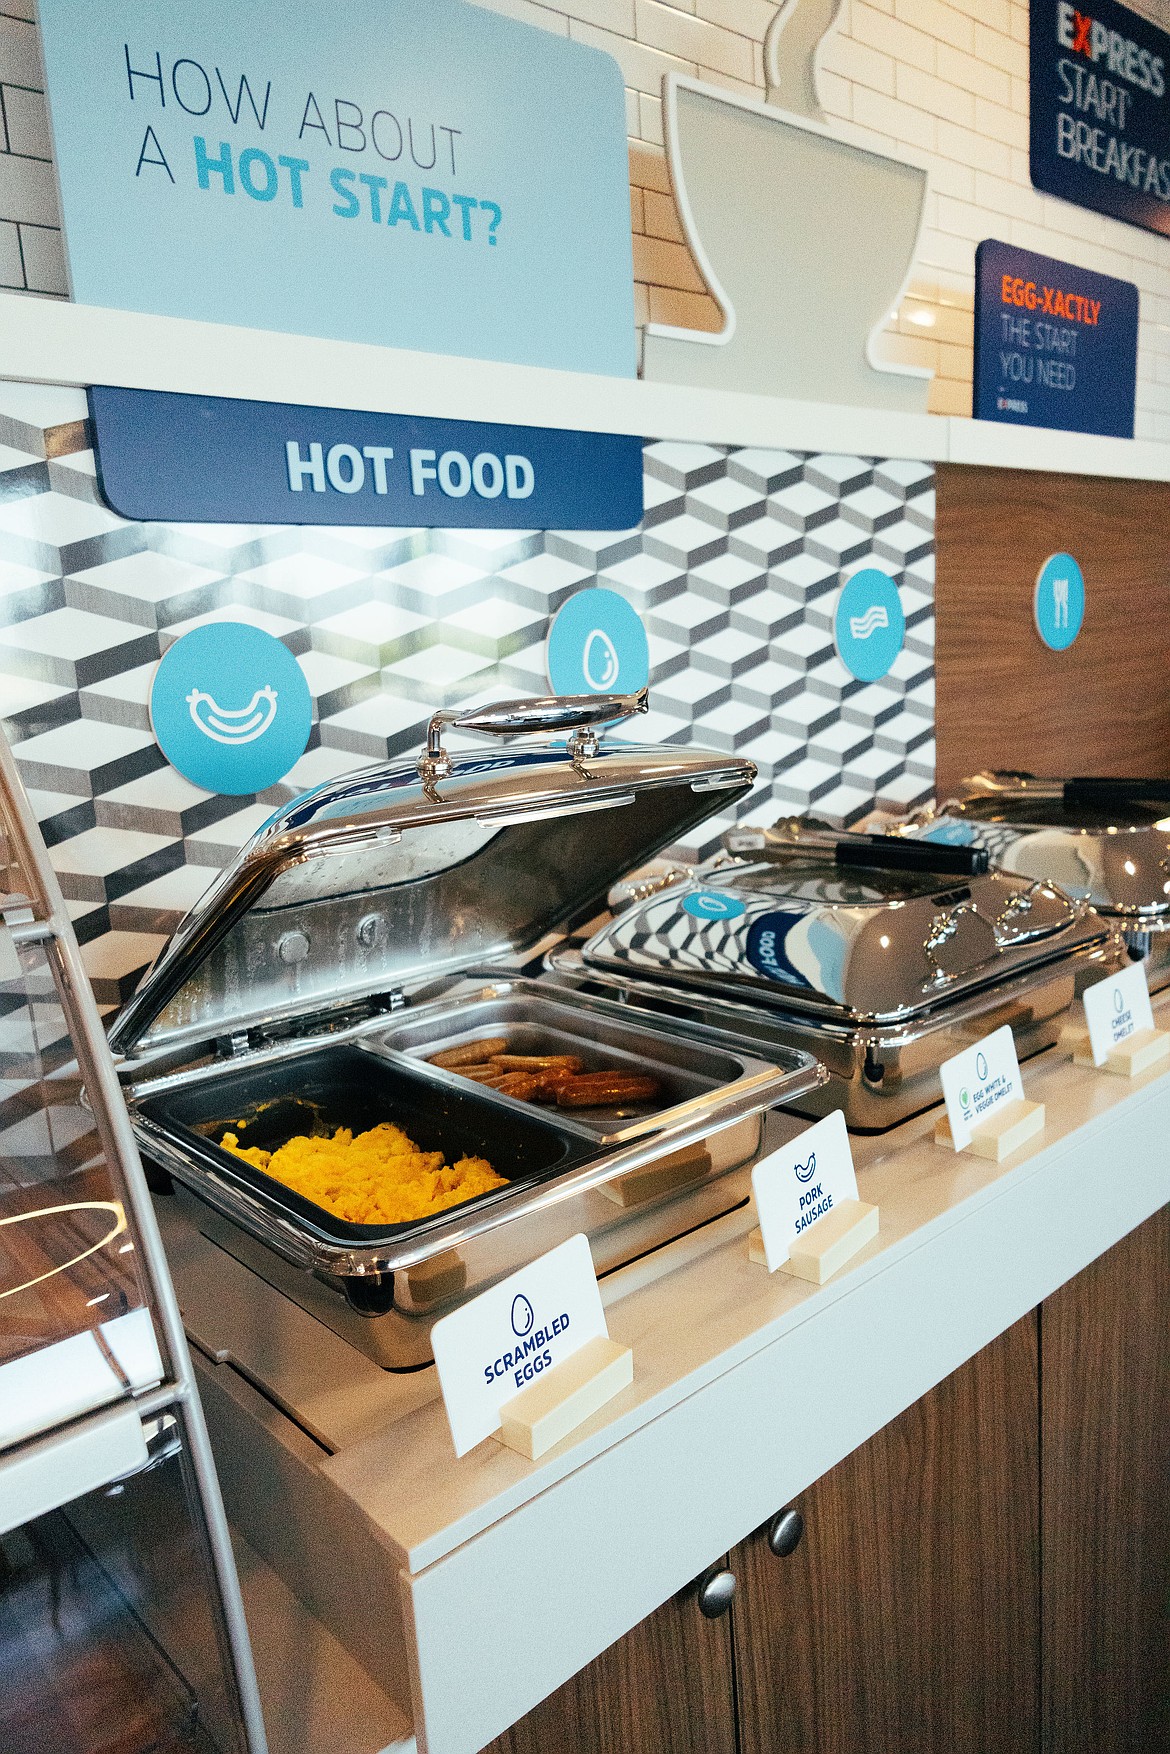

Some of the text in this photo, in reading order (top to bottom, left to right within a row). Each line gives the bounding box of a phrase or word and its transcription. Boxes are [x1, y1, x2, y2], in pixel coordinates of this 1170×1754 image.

[1057, 1, 1165, 98] EXPRESS
[124, 43, 463, 176] HOW ABOUT
[135, 125, 503, 246] A HOT START?
[1001, 274, 1101, 326] EGG-XACTLY
[1001, 313, 1078, 357] THE START
[999, 351, 1077, 391] YOU NEED
[285, 440, 536, 500] HOT FOOD
[973, 1089, 984, 1103] EGG
[985, 1077, 1001, 1095] WHITE
[975, 1082, 1013, 1114] VEGGIE OMELET
[794, 1195, 834, 1234] SAUSAGE
[799, 1183, 824, 1211] PORK
[484, 1313, 570, 1385] SCRAMBLED
[513, 1349, 553, 1388] EGGS
